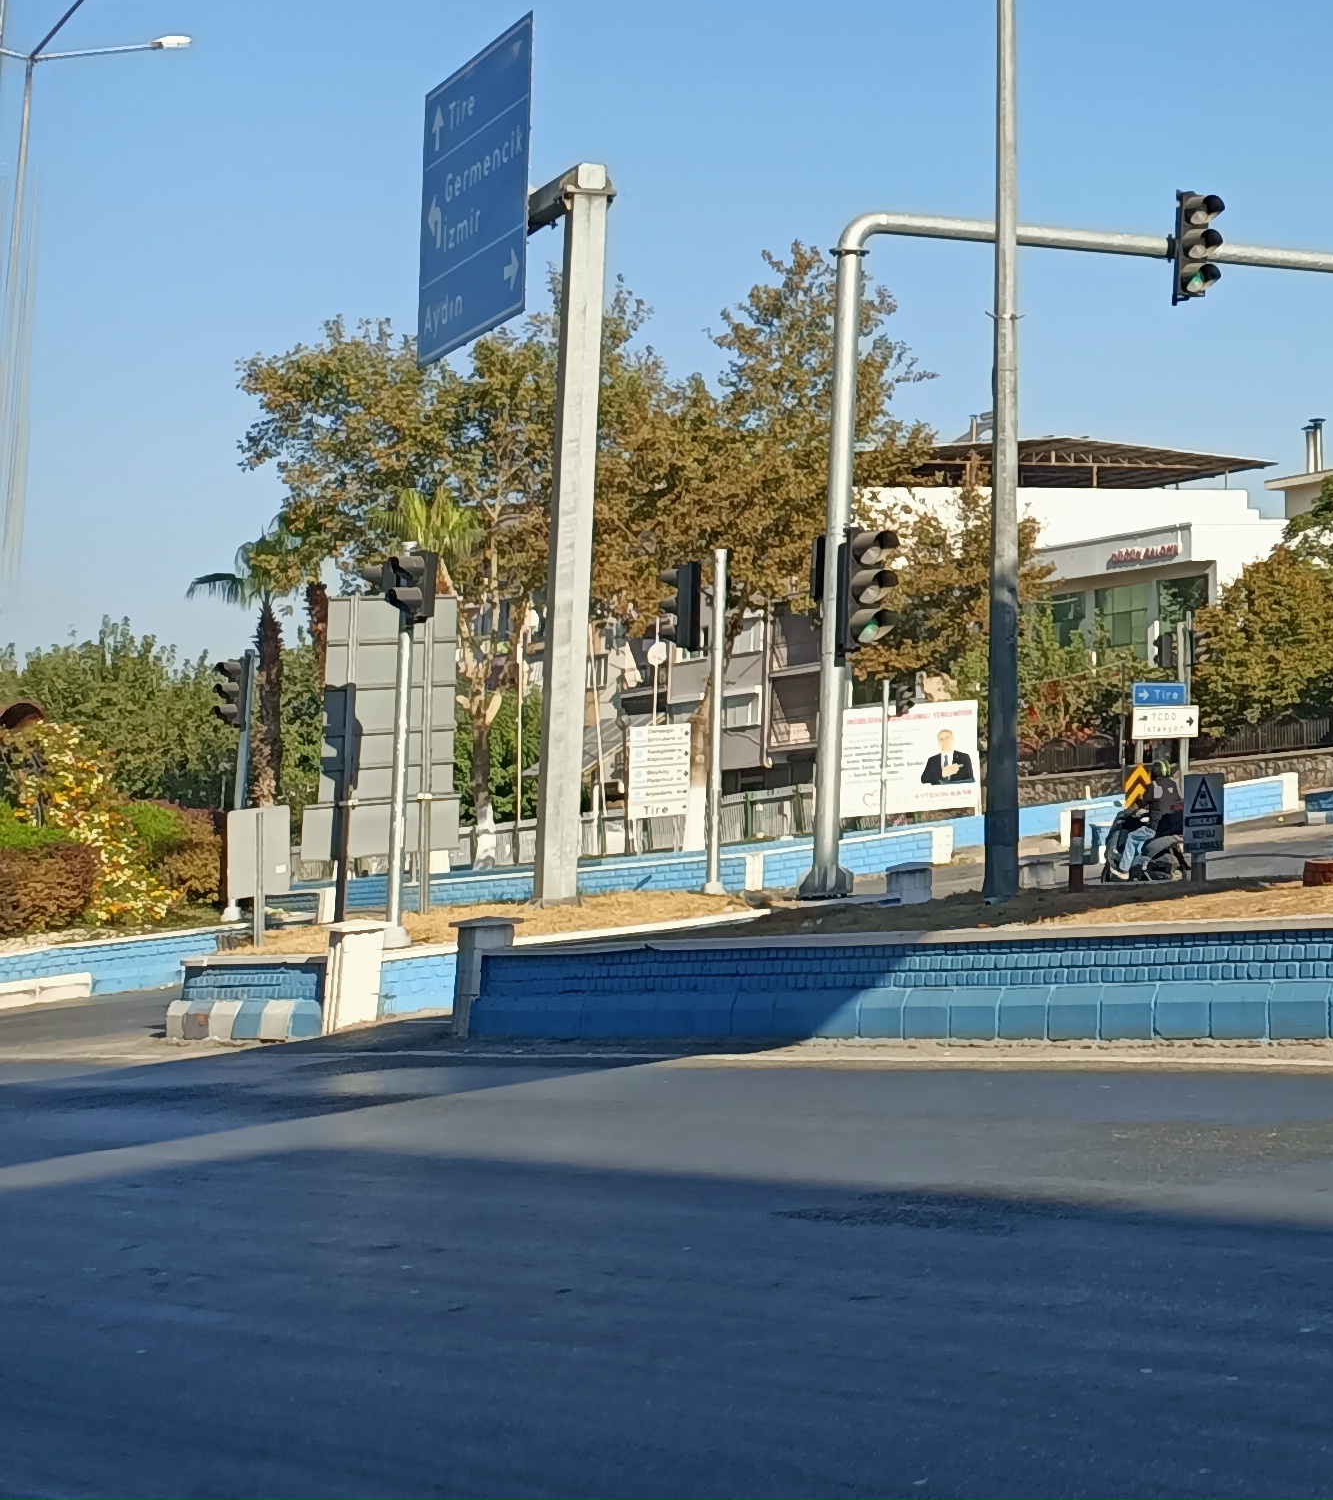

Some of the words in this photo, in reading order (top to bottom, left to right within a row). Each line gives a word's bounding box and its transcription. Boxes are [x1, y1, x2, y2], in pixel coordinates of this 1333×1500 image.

[448, 94, 476, 131] Tire
[444, 125, 524, 203] Germencik
[423, 293, 464, 339] Aydın
[1153, 688, 1179, 700] Tire
[1151, 712, 1177, 721] TCDD
[643, 805, 669, 816] Tire
